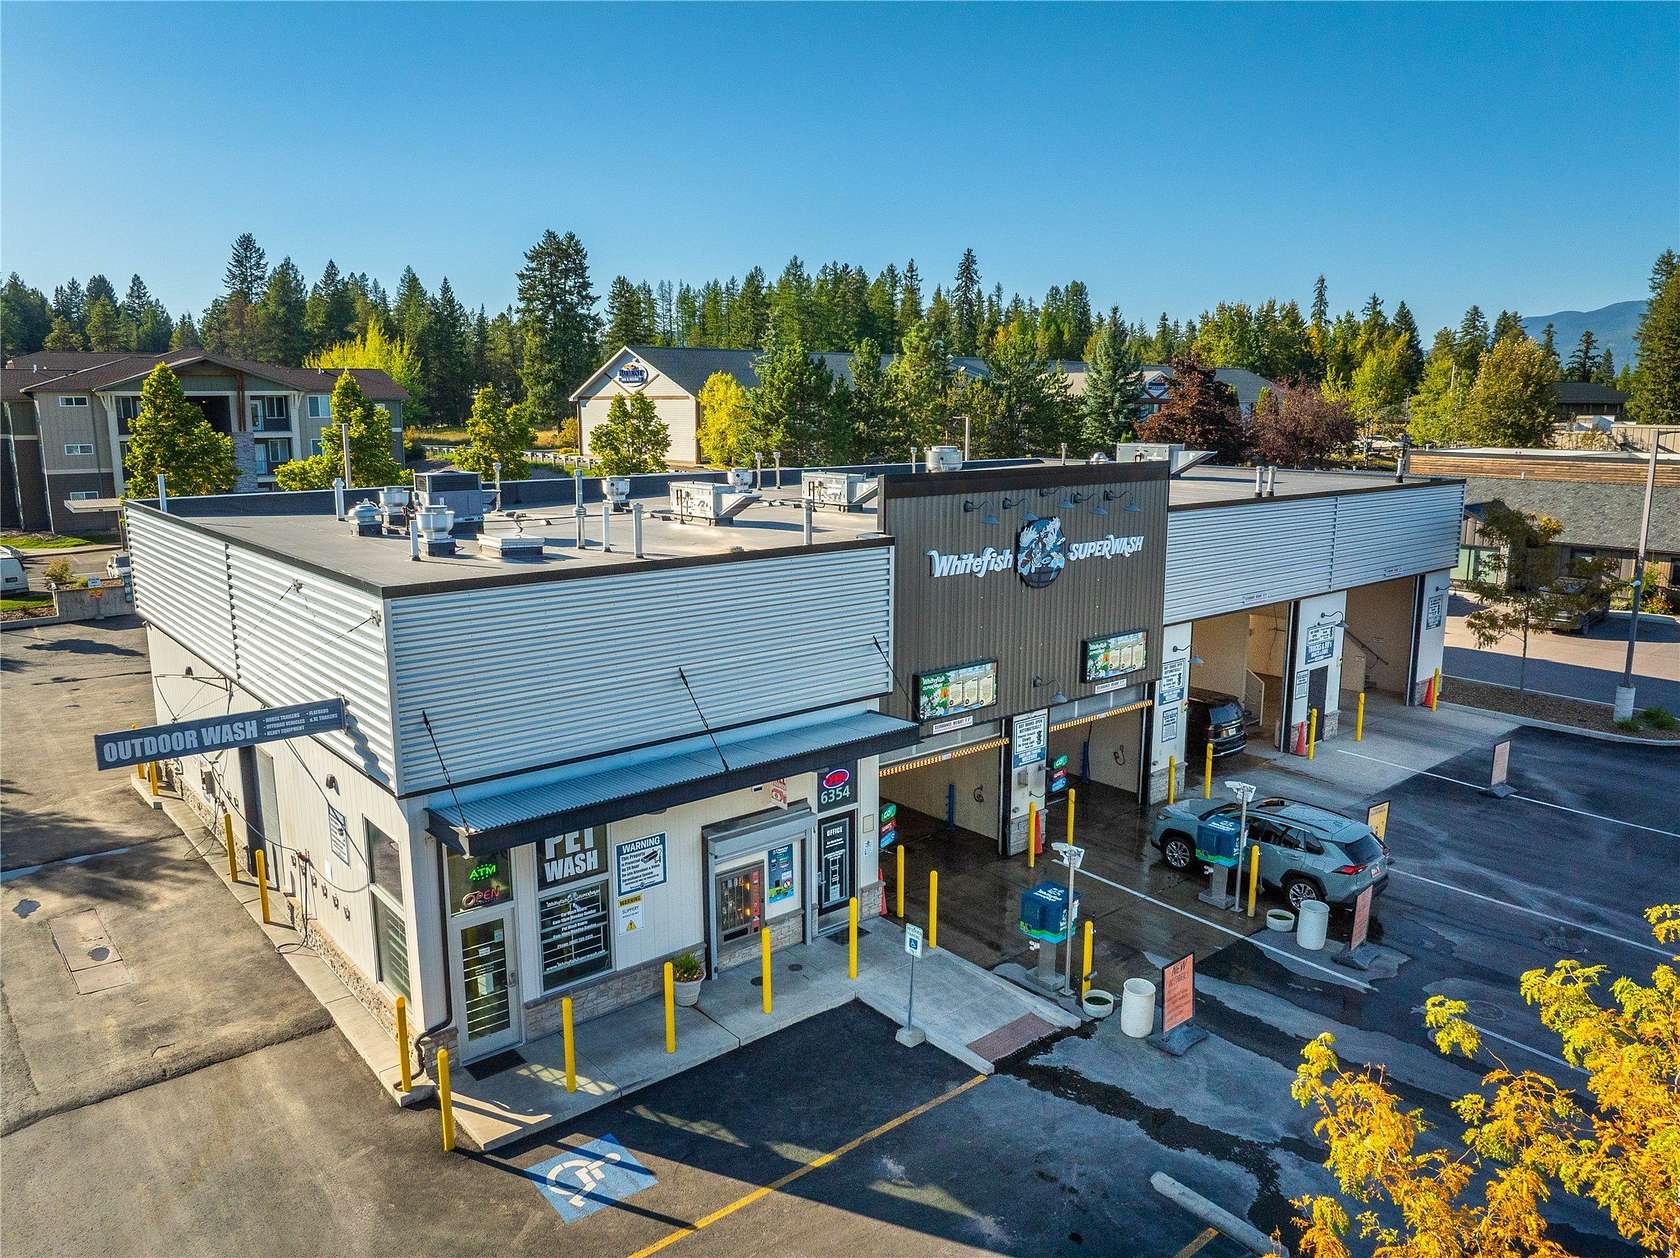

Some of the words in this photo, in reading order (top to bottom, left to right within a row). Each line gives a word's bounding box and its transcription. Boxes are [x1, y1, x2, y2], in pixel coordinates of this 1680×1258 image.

[1068, 534, 1145, 561] SUPERWASH
[927, 547, 1014, 578] Whitefish
[103, 730, 199, 762] OUTDOOR
[201, 719, 258, 746] WASH
[821, 785, 850, 805] 6354
[622, 836, 660, 854] WARNING
[469, 865, 497, 880] ATM
[544, 850, 599, 882] WASH
[462, 886, 501, 908] OPEN
